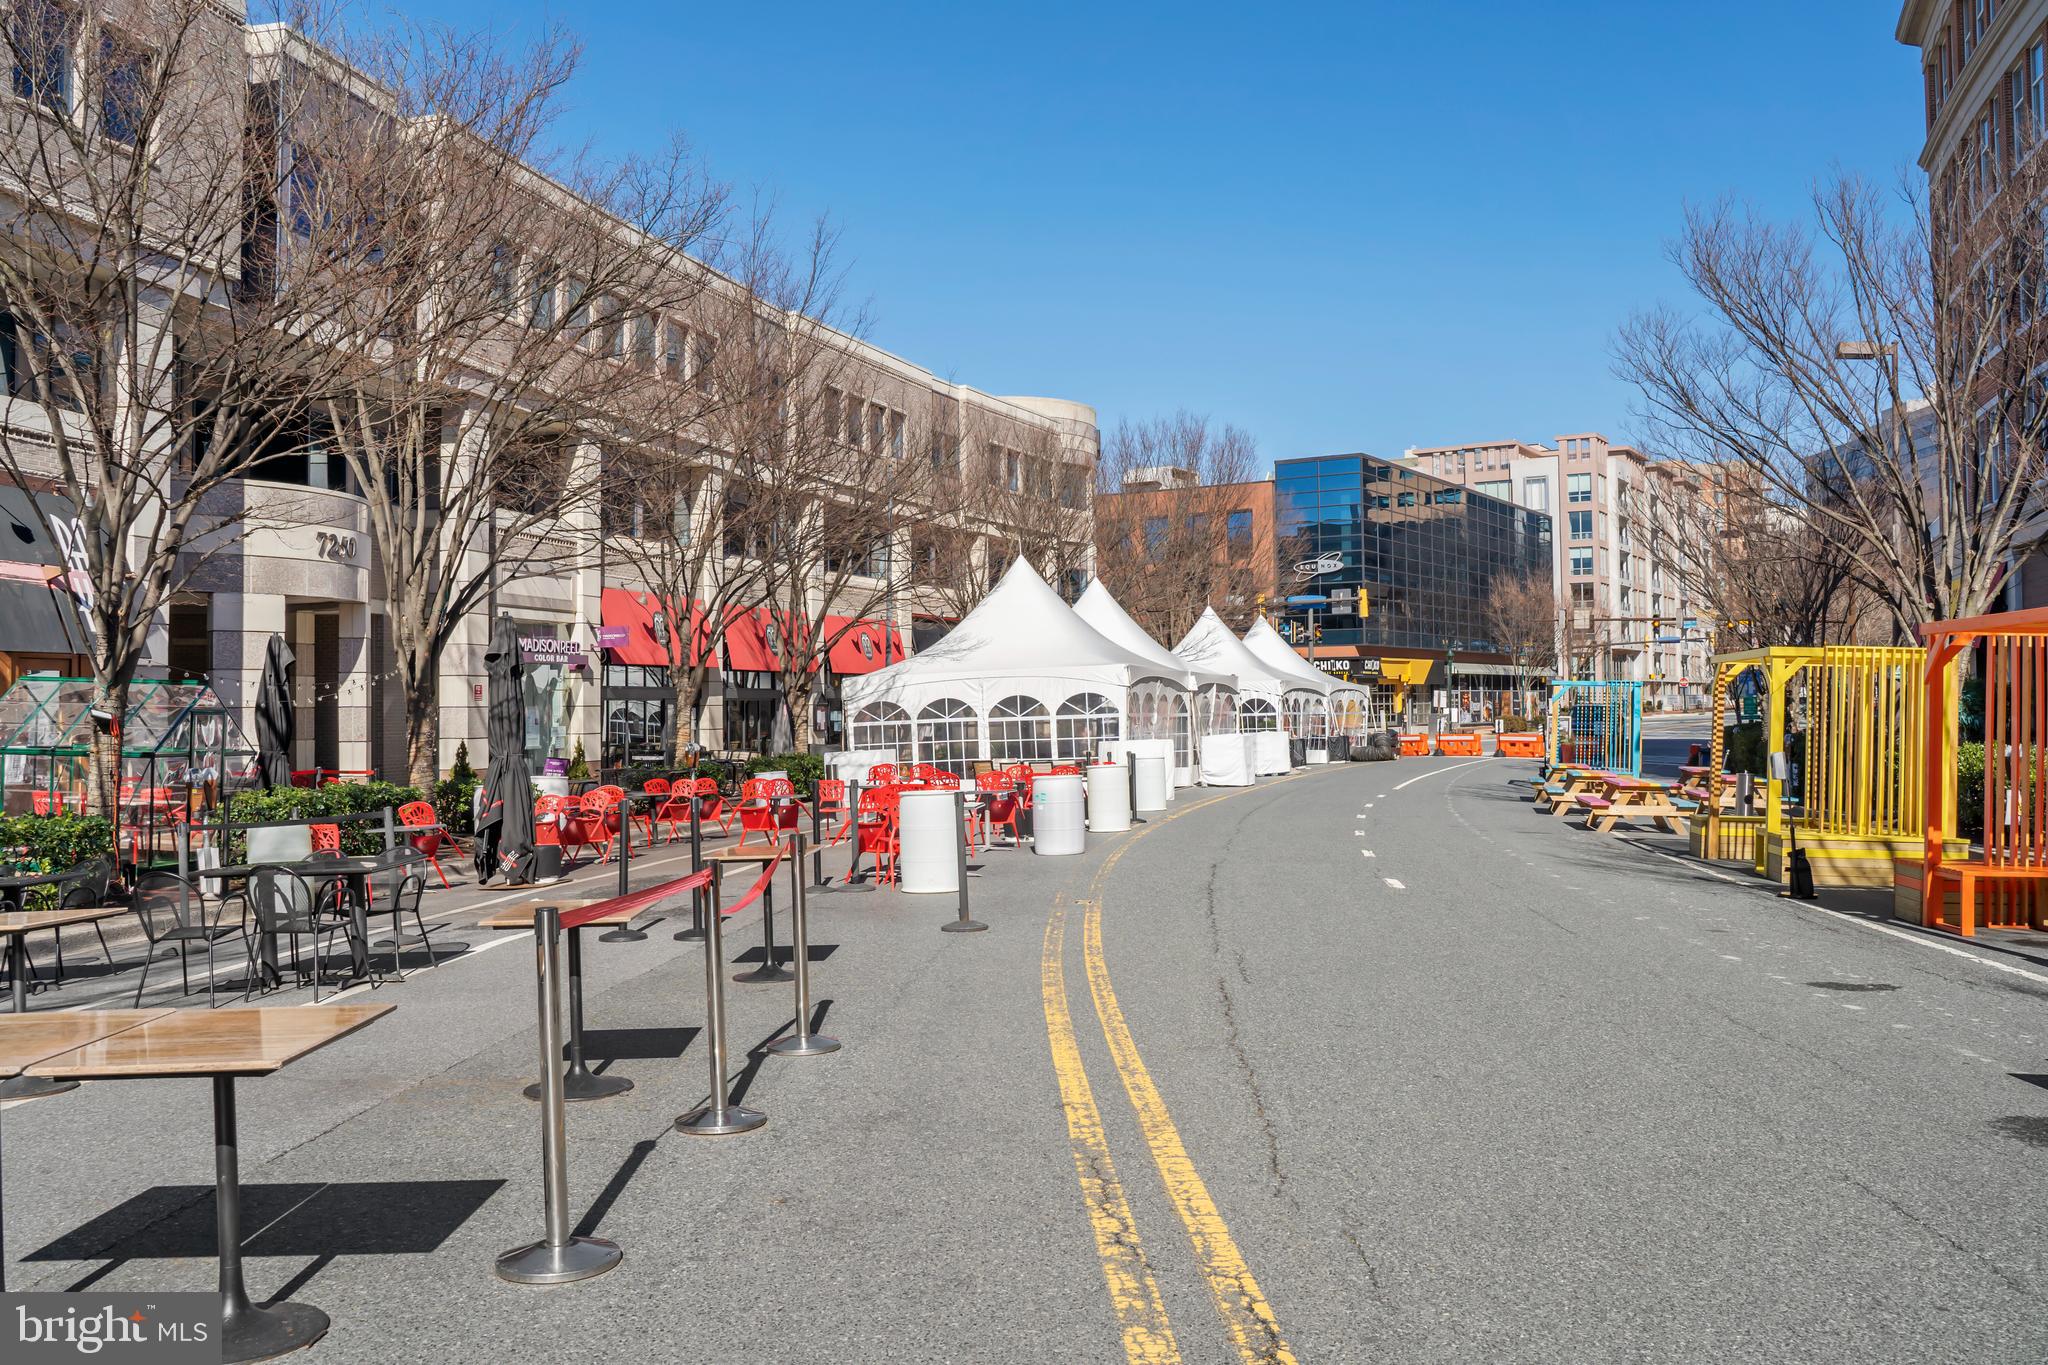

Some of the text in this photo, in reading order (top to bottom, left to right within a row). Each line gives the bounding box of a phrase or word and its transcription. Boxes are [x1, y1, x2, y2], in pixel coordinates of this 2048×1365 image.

[316, 531, 357, 562] 7250
[534, 654, 569, 663] COLOR BAR
